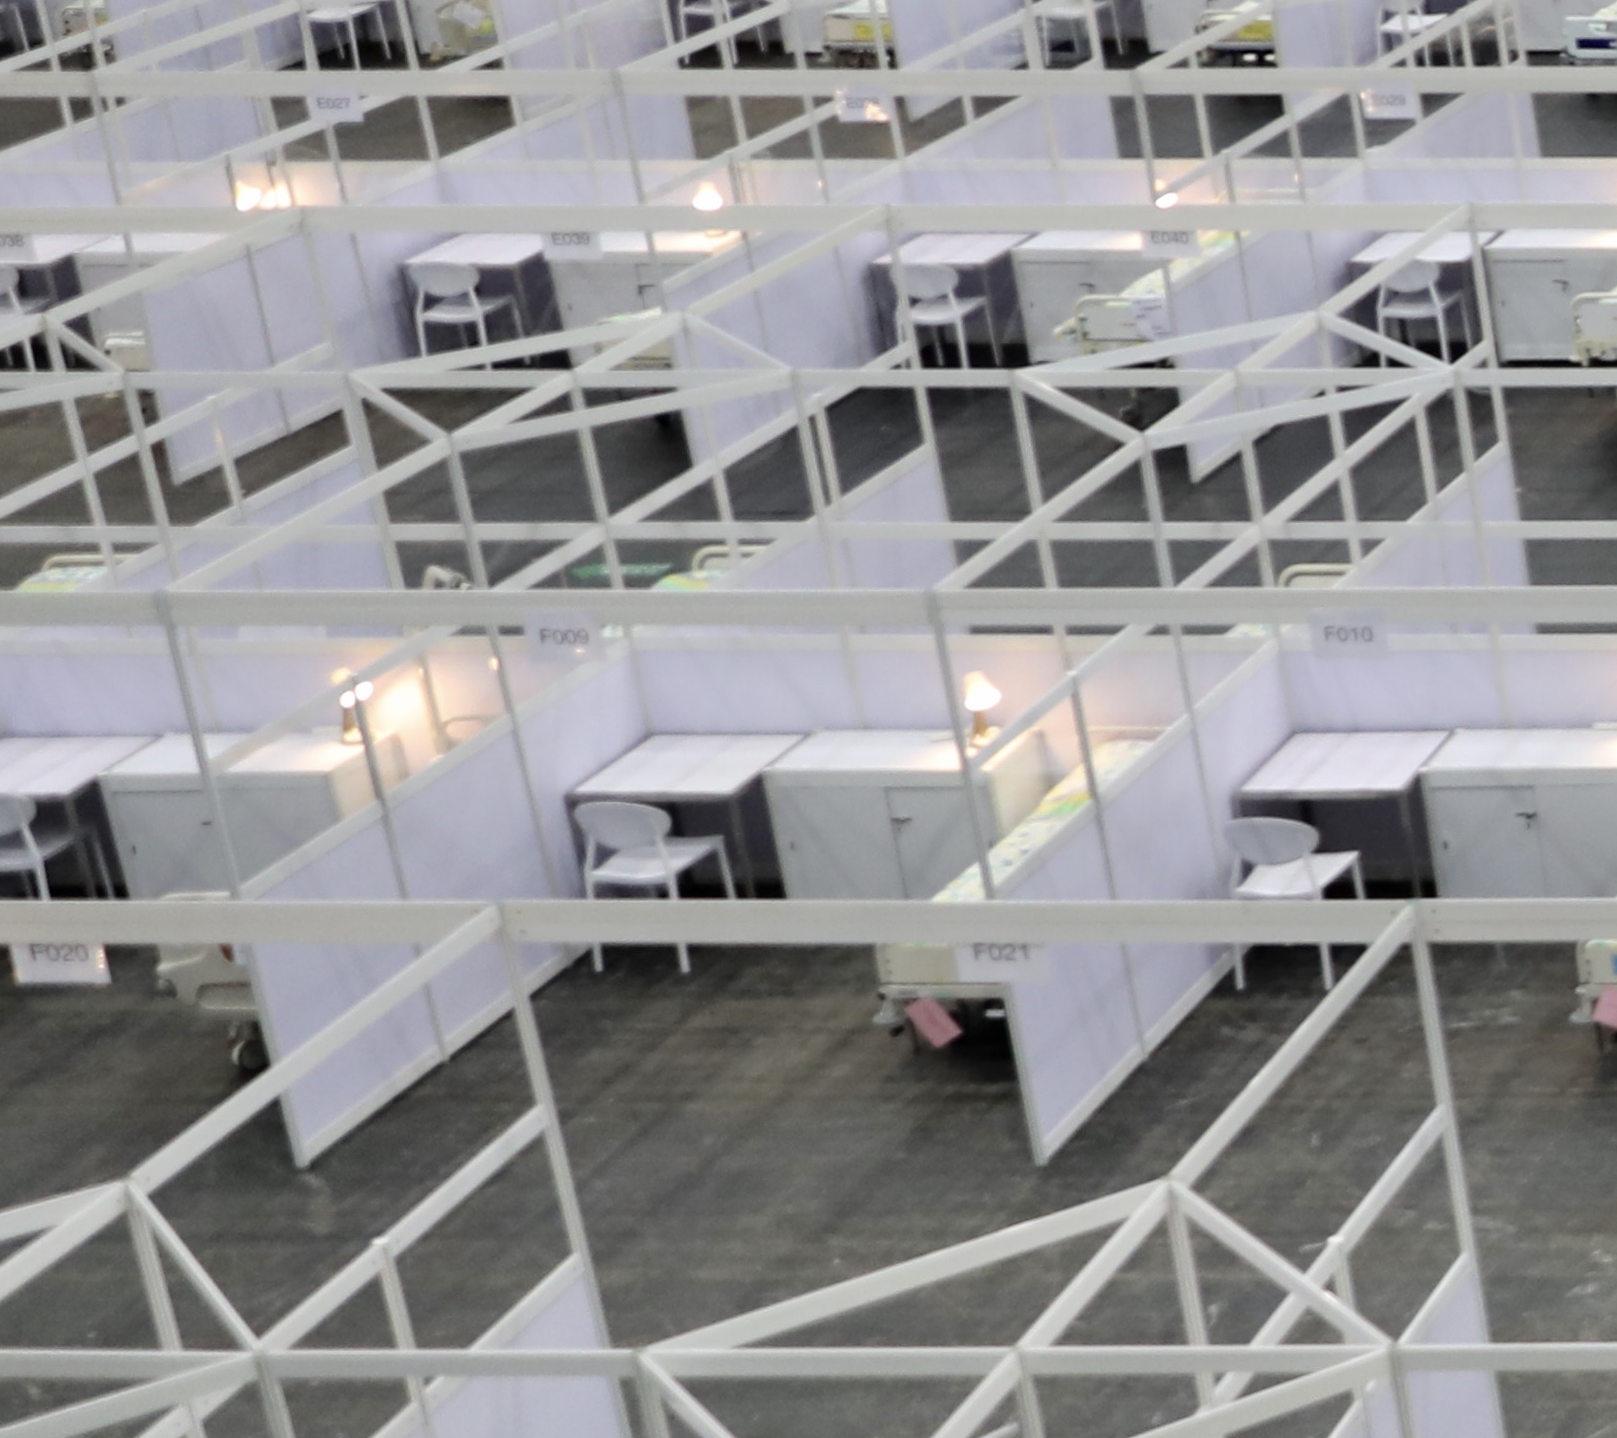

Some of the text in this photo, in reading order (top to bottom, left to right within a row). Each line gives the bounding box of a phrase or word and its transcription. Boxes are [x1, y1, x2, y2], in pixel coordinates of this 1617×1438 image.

[317, 98, 350, 109] E027
[1151, 231, 1189, 244] E040
[539, 628, 589, 645] F009
[1324, 626, 1374, 643] F010
[29, 944, 89, 962] F020
[973, 942, 1030, 961] F021
